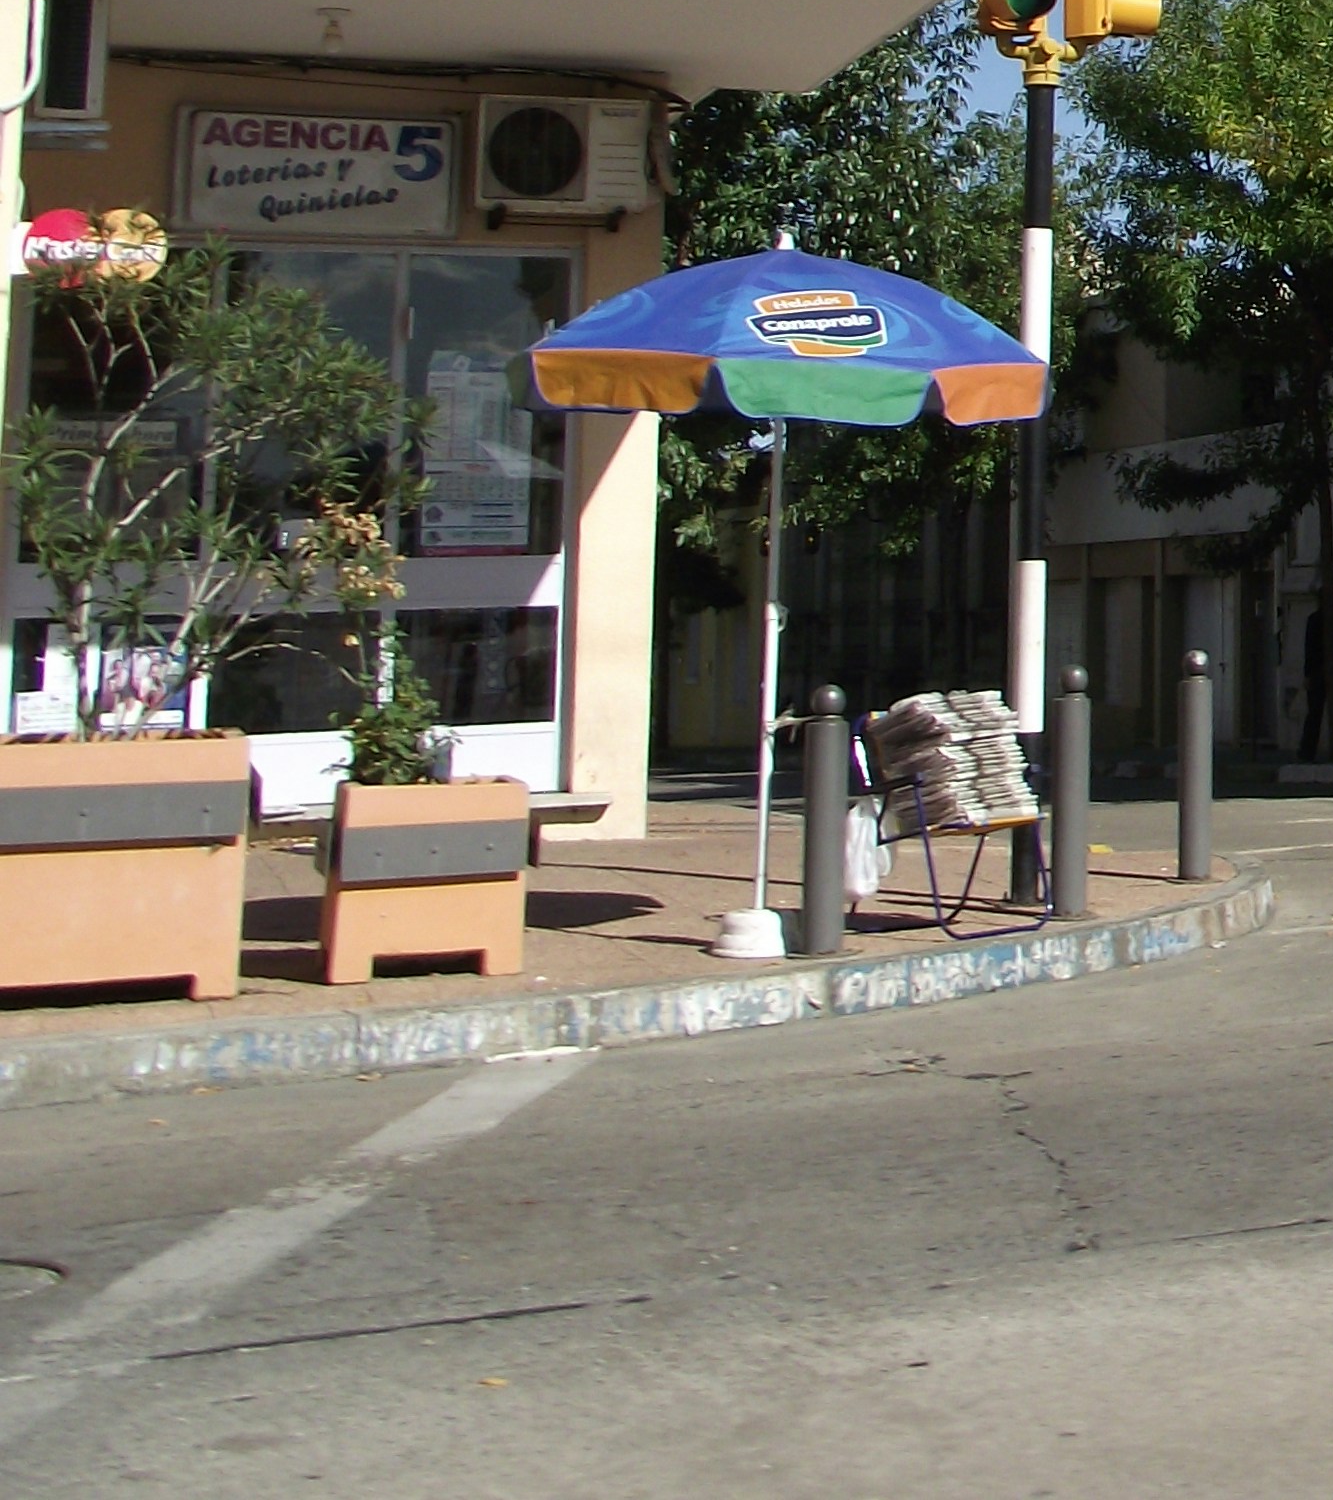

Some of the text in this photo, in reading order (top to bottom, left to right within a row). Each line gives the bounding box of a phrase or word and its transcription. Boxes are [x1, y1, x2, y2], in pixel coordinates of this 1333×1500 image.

[203, 117, 444, 182] AGENCIA 5
[258, 185, 398, 222] Quinielas
[772, 296, 842, 310] Helados
[762, 314, 873, 331] Conaprole
